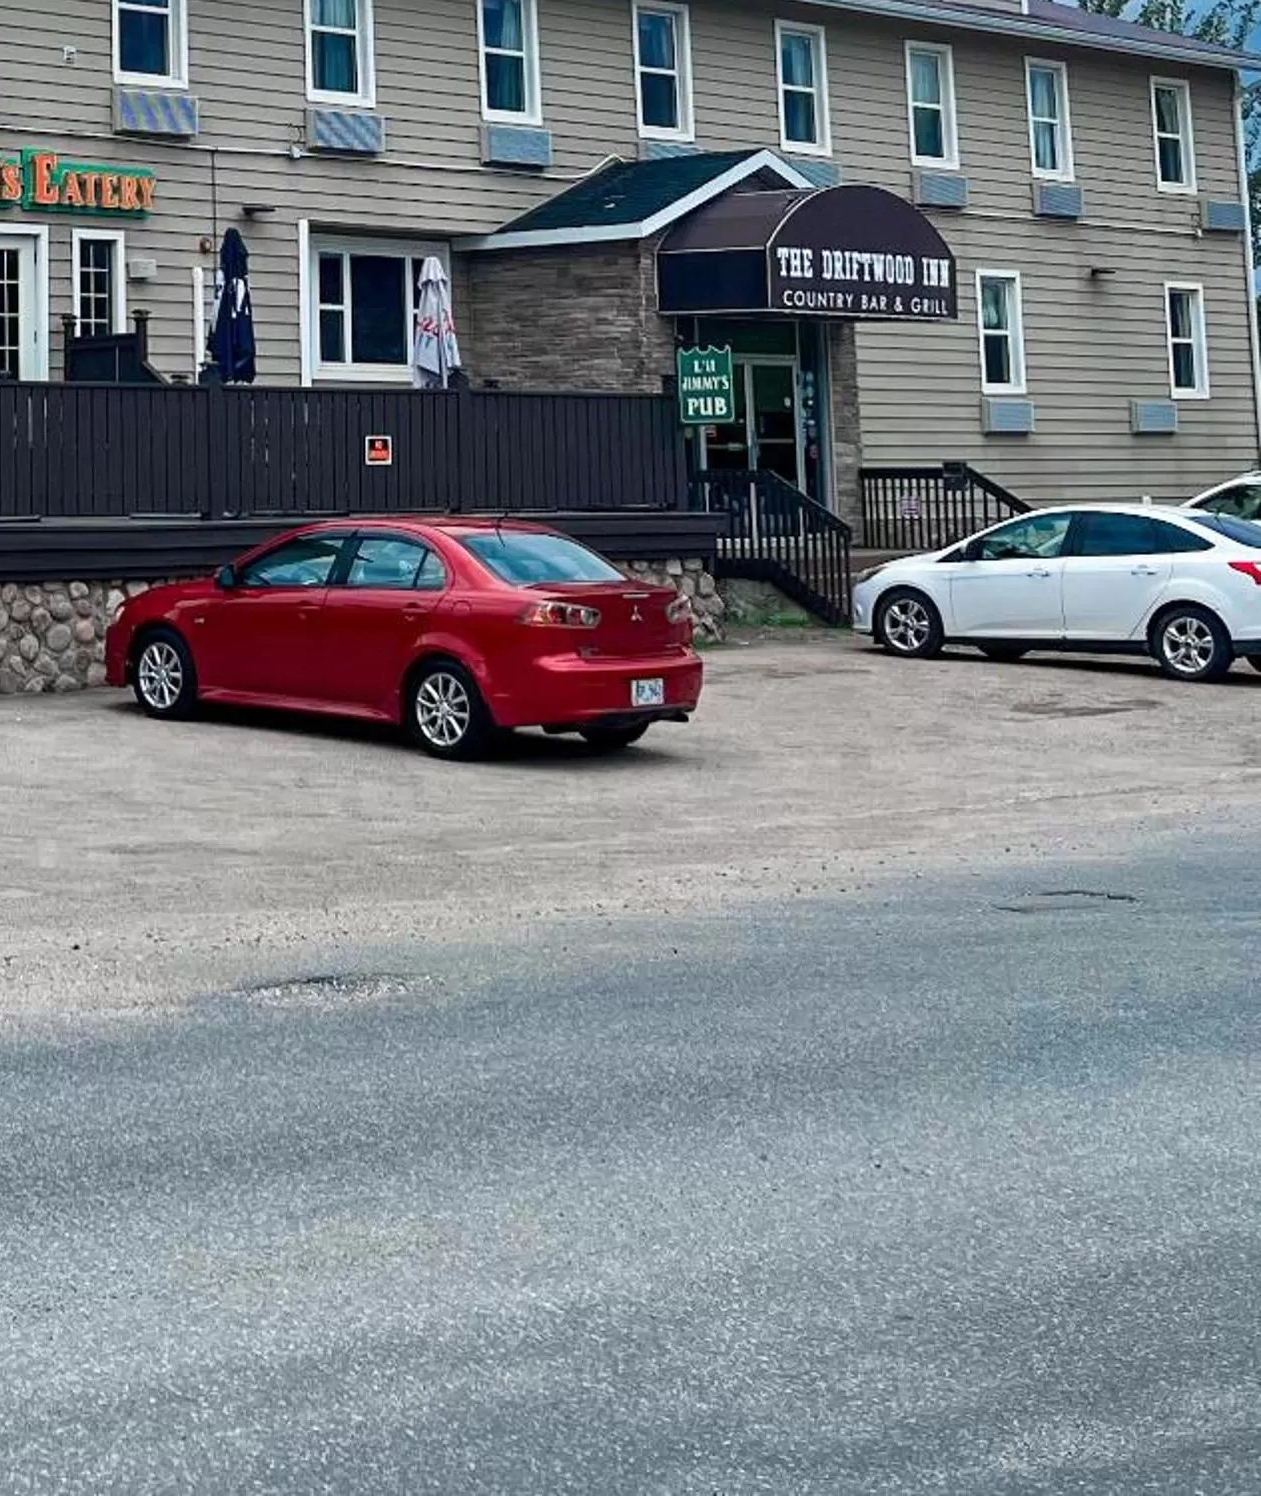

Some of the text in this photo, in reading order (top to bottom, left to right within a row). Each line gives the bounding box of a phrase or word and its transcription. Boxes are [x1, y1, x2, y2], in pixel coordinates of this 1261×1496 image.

[33, 154, 156, 210] EATERY
[776, 247, 950, 287] THE DRIFTWOOD INN
[783, 290, 949, 315] COUNTRY BAR & GRILL
[681, 375, 730, 391] JIMMY'S
[687, 397, 727, 416] PUB
